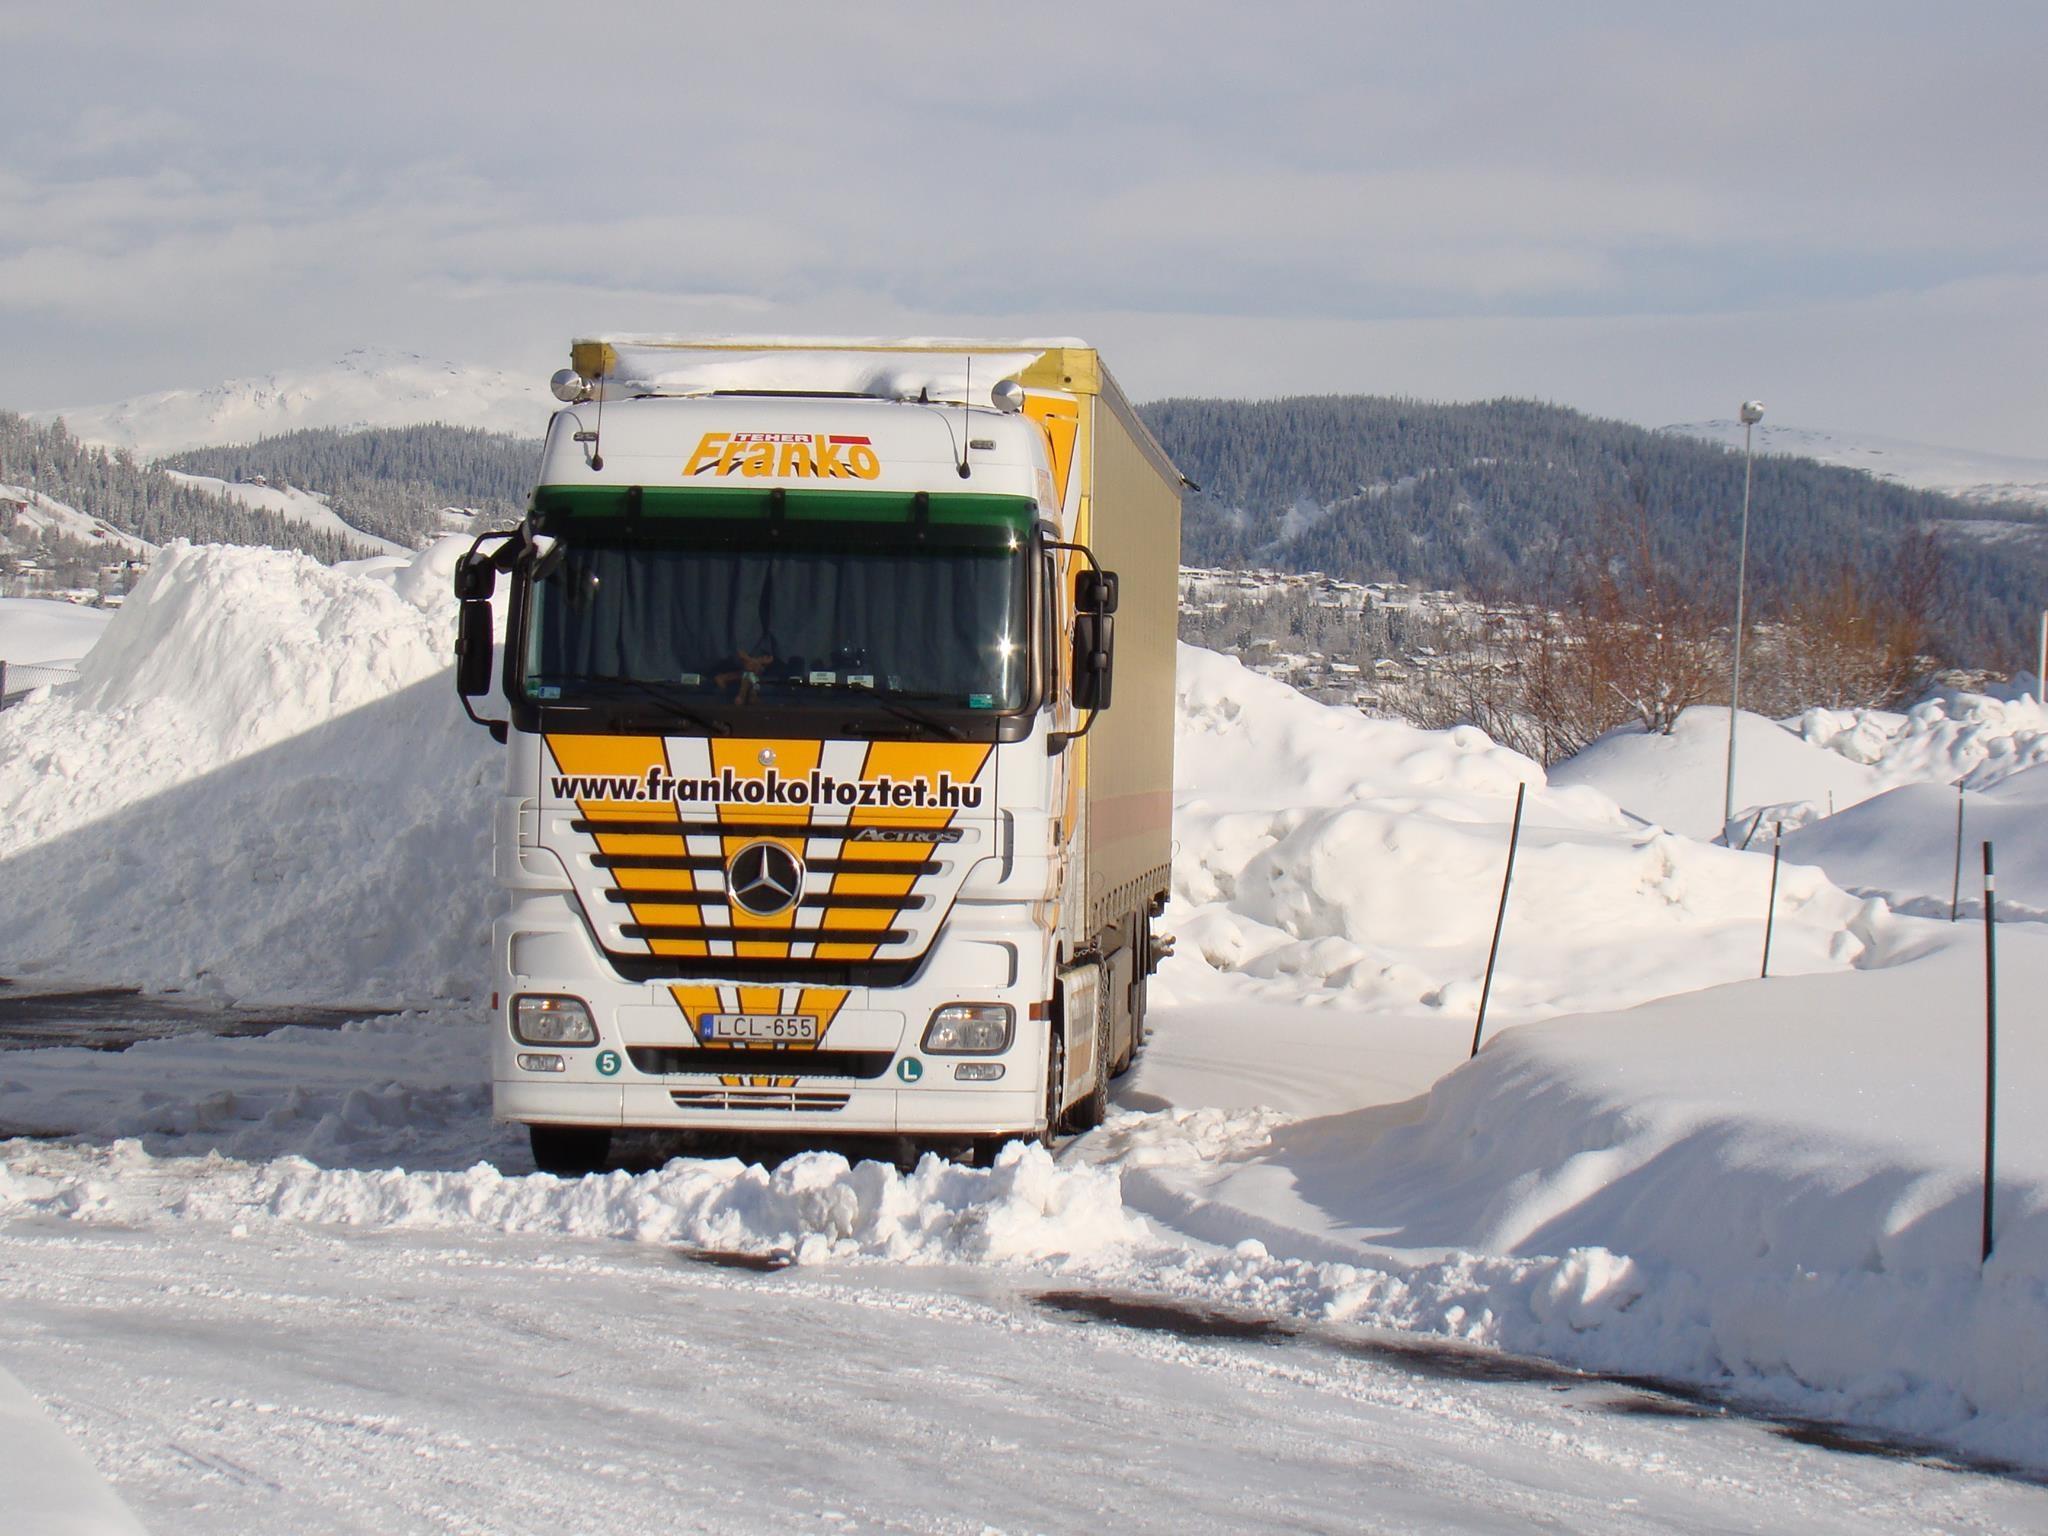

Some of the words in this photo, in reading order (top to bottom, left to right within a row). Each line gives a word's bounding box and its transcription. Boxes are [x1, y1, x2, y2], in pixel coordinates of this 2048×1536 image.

[737, 433, 810, 442] TEHER
[682, 433, 880, 480] Franko
[551, 768, 982, 808] www.frankokoltoztet.hu
[704, 1027, 711, 1035] H
[718, 1017, 812, 1037] LCL-655
[602, 1054, 616, 1072] 5
[903, 1060, 918, 1080] L
